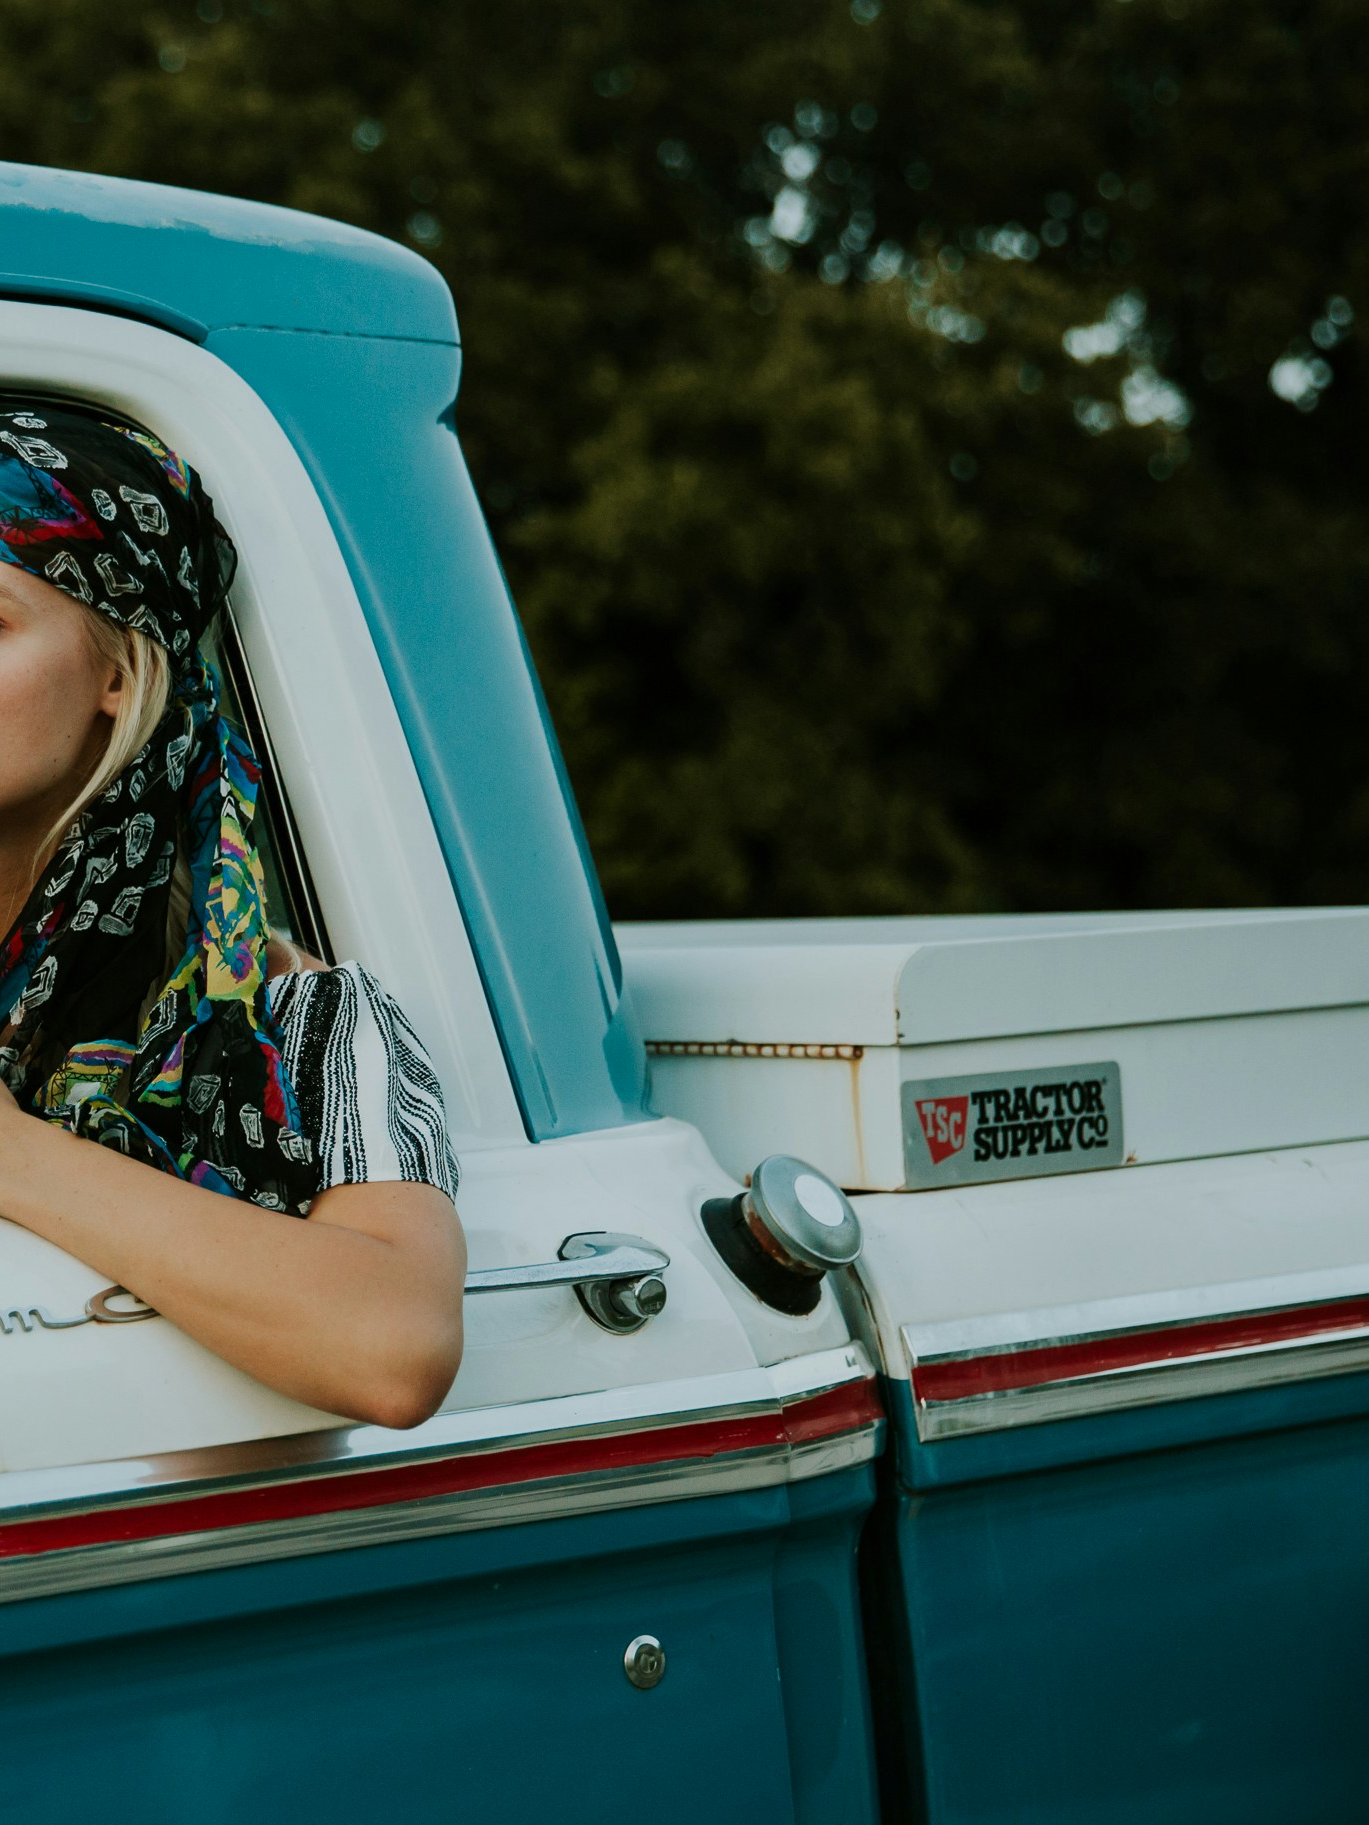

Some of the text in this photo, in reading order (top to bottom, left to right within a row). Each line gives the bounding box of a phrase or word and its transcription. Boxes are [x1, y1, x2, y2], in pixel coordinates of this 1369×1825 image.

[970, 1080, 1105, 1125] TRACTOR
[921, 1101, 963, 1150] TSC
[973, 1117, 1076, 1162] SUPPLY
